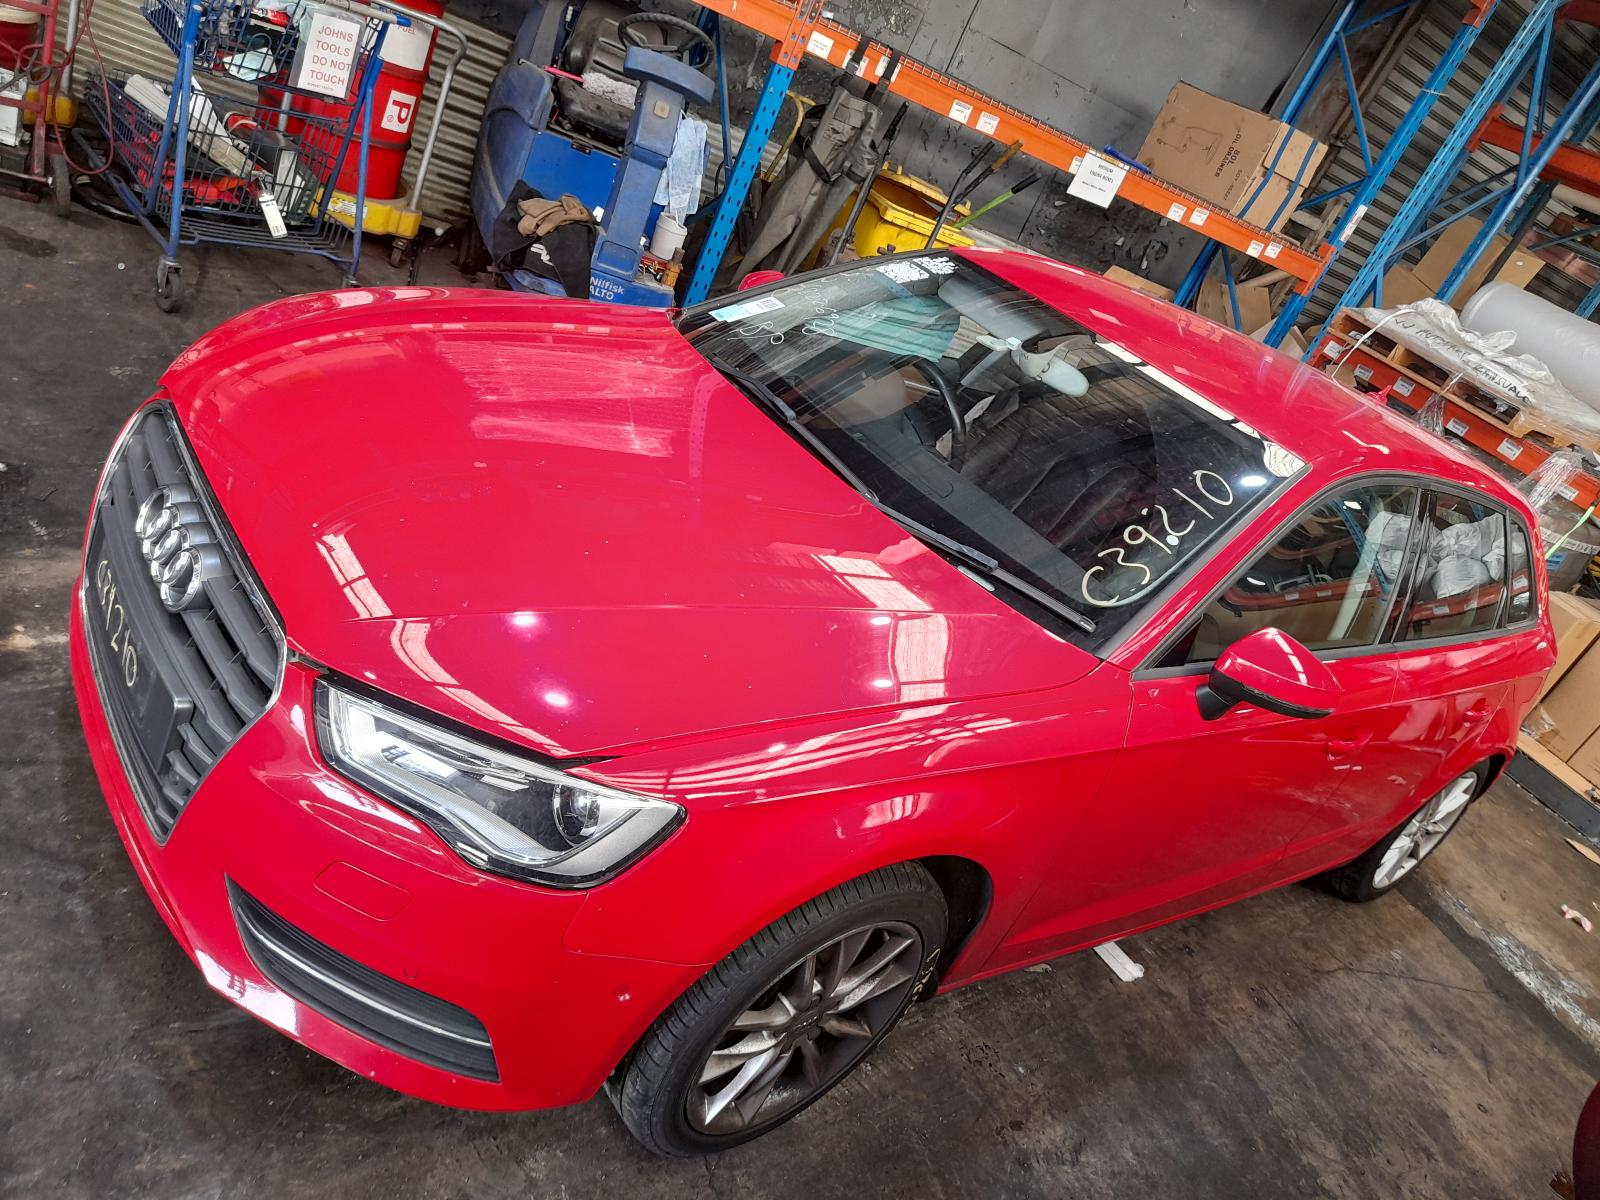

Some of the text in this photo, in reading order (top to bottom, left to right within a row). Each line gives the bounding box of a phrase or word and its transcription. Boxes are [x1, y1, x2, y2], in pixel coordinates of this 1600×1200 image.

[318, 26, 353, 42] JOHNS
[316, 40, 351, 57] TOOLS
[312, 55, 352, 72] DO NOT
[310, 69, 345, 86] TOUCH
[392, 100, 412, 125] P
[589, 277, 624, 294] Nilfisk
[589, 286, 614, 300] ALTO
